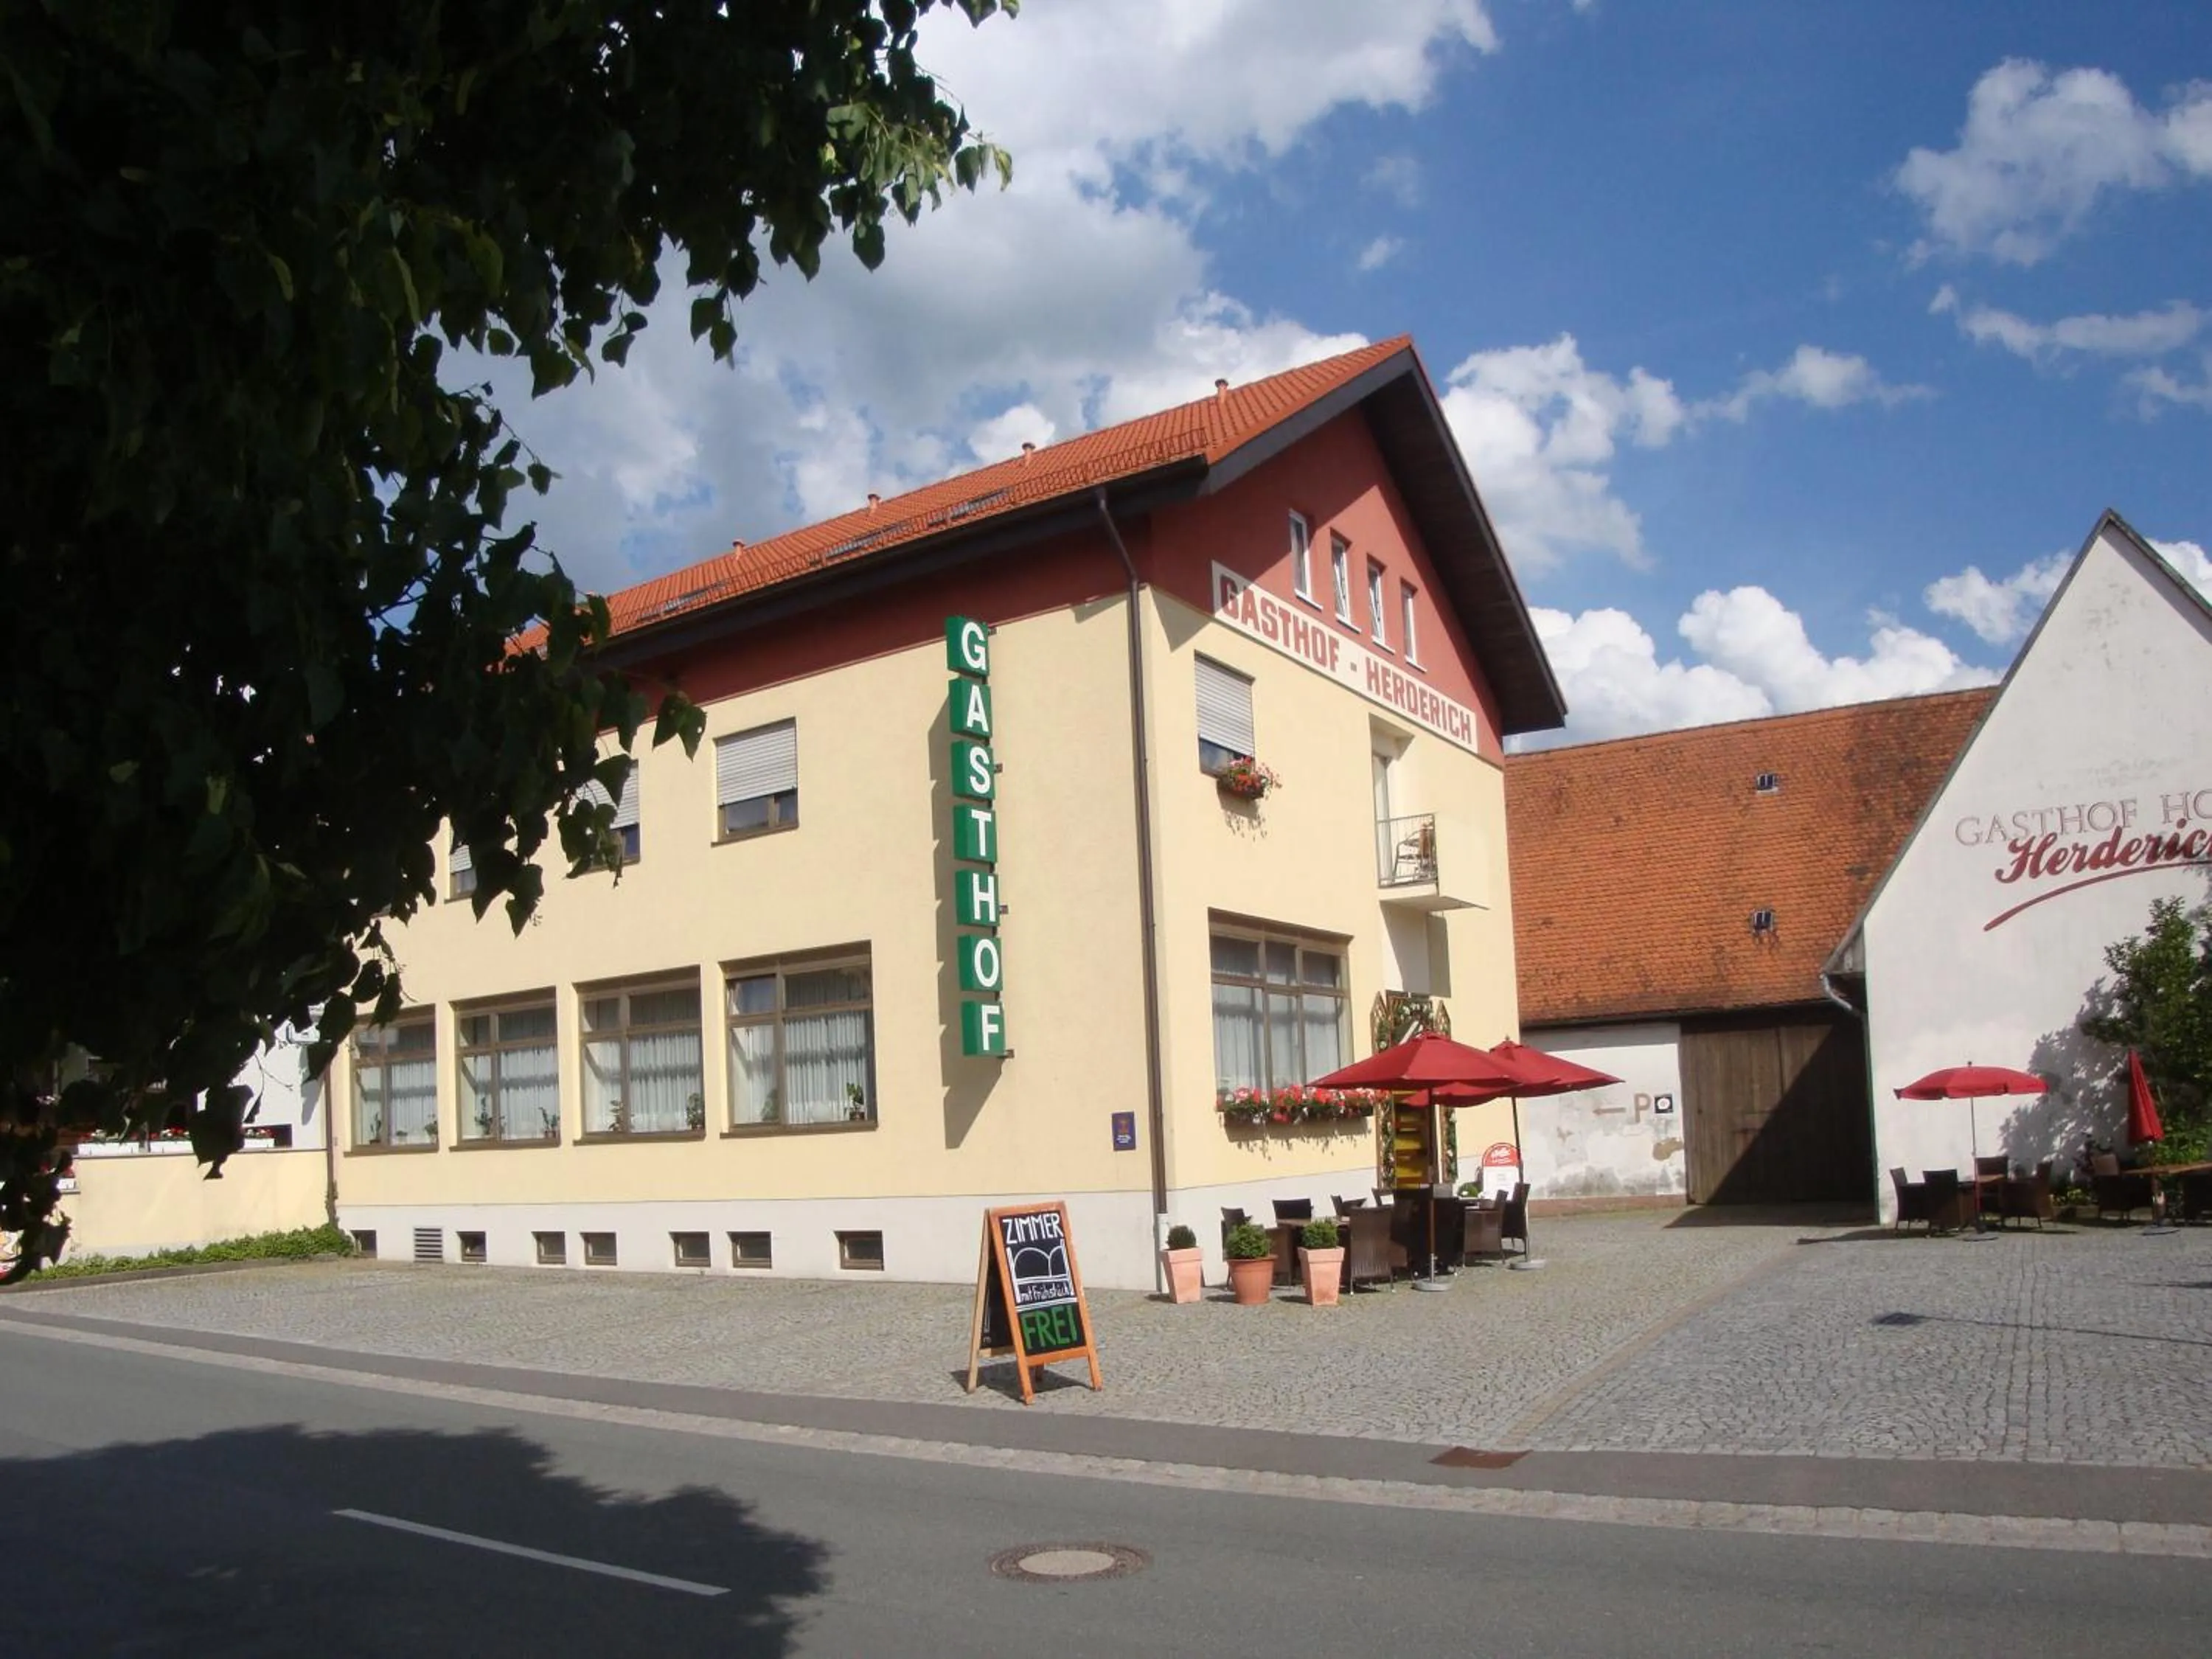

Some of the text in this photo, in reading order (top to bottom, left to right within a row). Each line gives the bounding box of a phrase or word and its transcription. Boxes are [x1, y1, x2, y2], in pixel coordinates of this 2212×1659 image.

[1220, 574, 1340, 672] GASTHOF
[1366, 656, 1472, 745] HERDERICH
[961, 621, 1001, 1051] GASTHOF
[1955, 799, 2138, 846] GASTHOF
[1994, 818, 2212, 883] Herderic
[1634, 1093, 1652, 1123] P
[1002, 1213, 1064, 1245] ZIMMER
[1019, 1306, 1077, 1349] FREI
